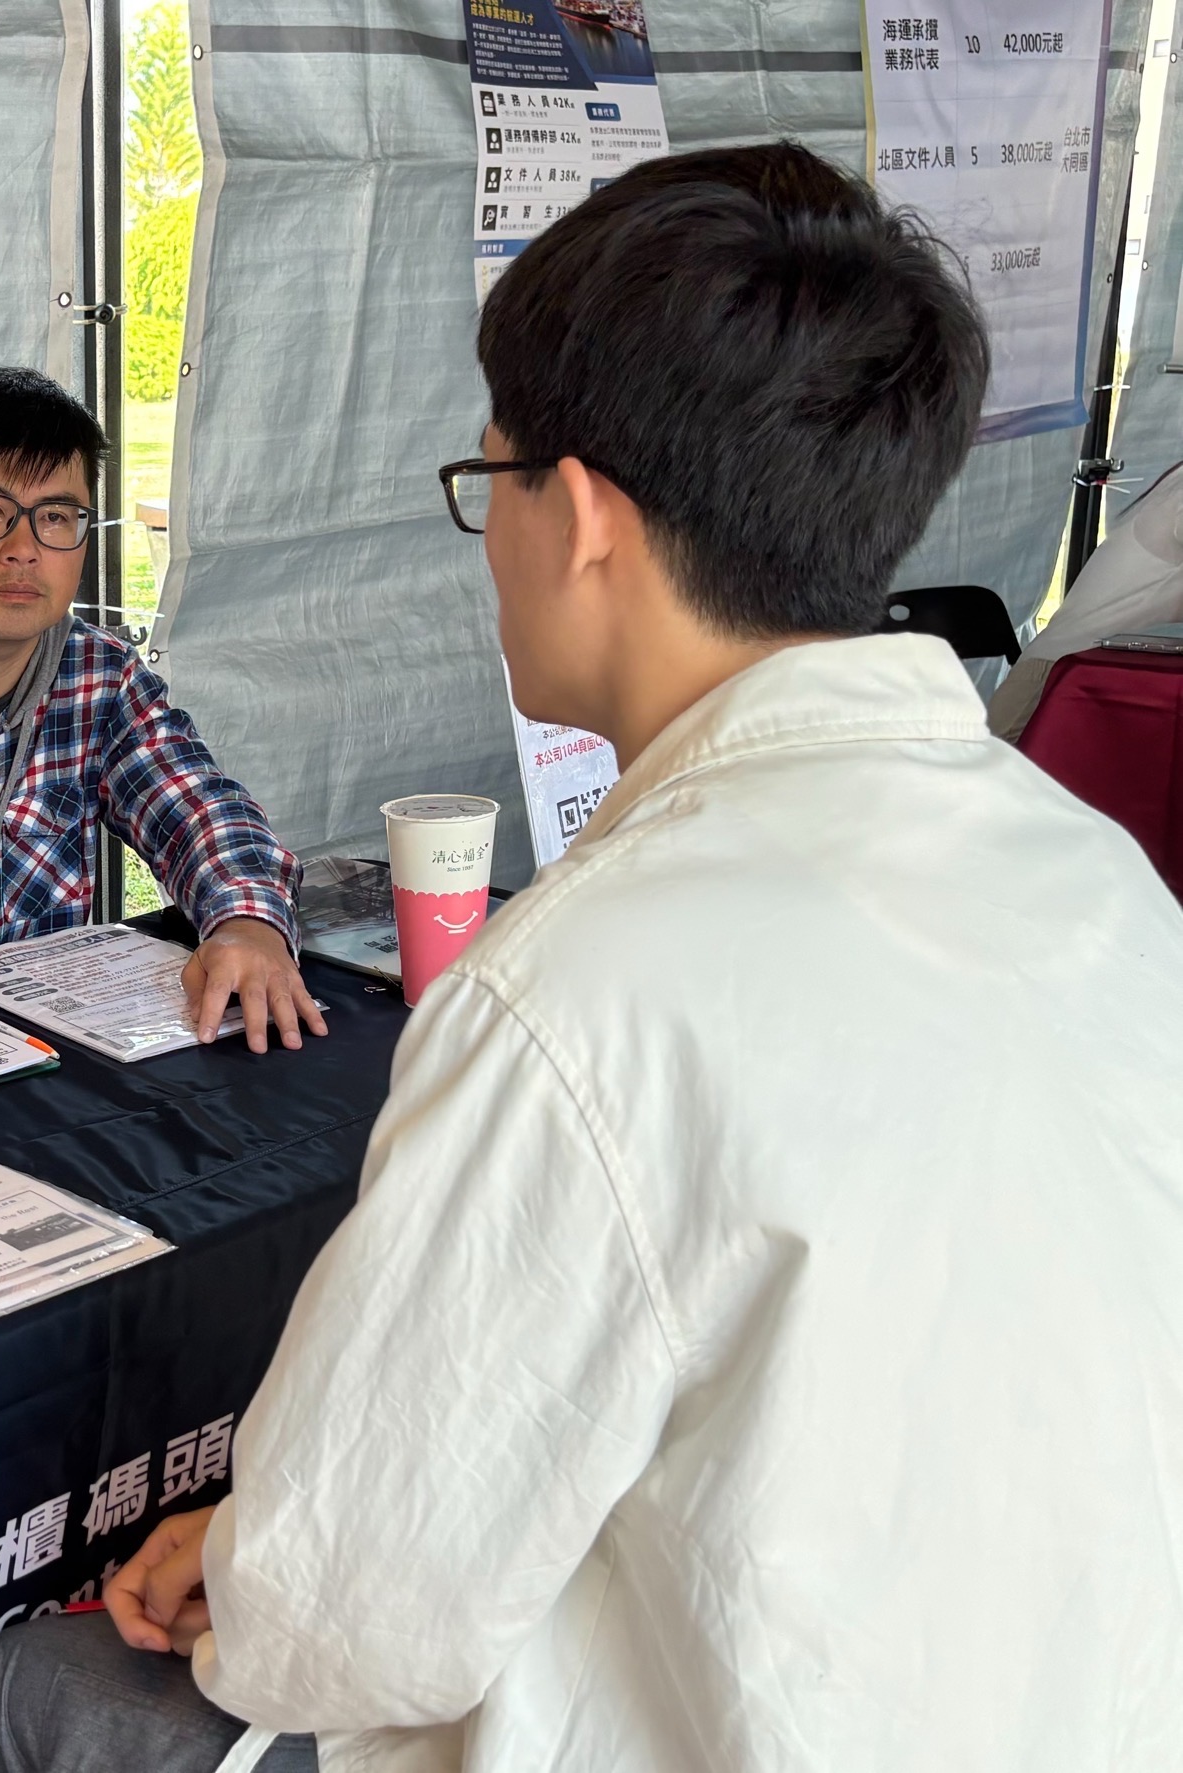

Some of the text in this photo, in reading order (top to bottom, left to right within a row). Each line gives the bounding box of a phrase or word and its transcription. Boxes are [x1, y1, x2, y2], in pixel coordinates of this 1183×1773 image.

[883, 18, 939, 42] 海運承攬
[965, 32, 1064, 55] 10 42,000元起
[884, 48, 940, 71] 業務代表
[1064, 126, 1091, 148] 台北市
[878, 146, 956, 171] 北區文件人員
[971, 141, 1053, 166] 5 38,000元起
[1060, 151, 1089, 173] 大同區
[504, 167, 557, 182] 文件人員
[556, 206, 568, 218] 33
[991, 247, 1041, 274] 33,000元起
[432, 846, 485, 864] 清心福全
